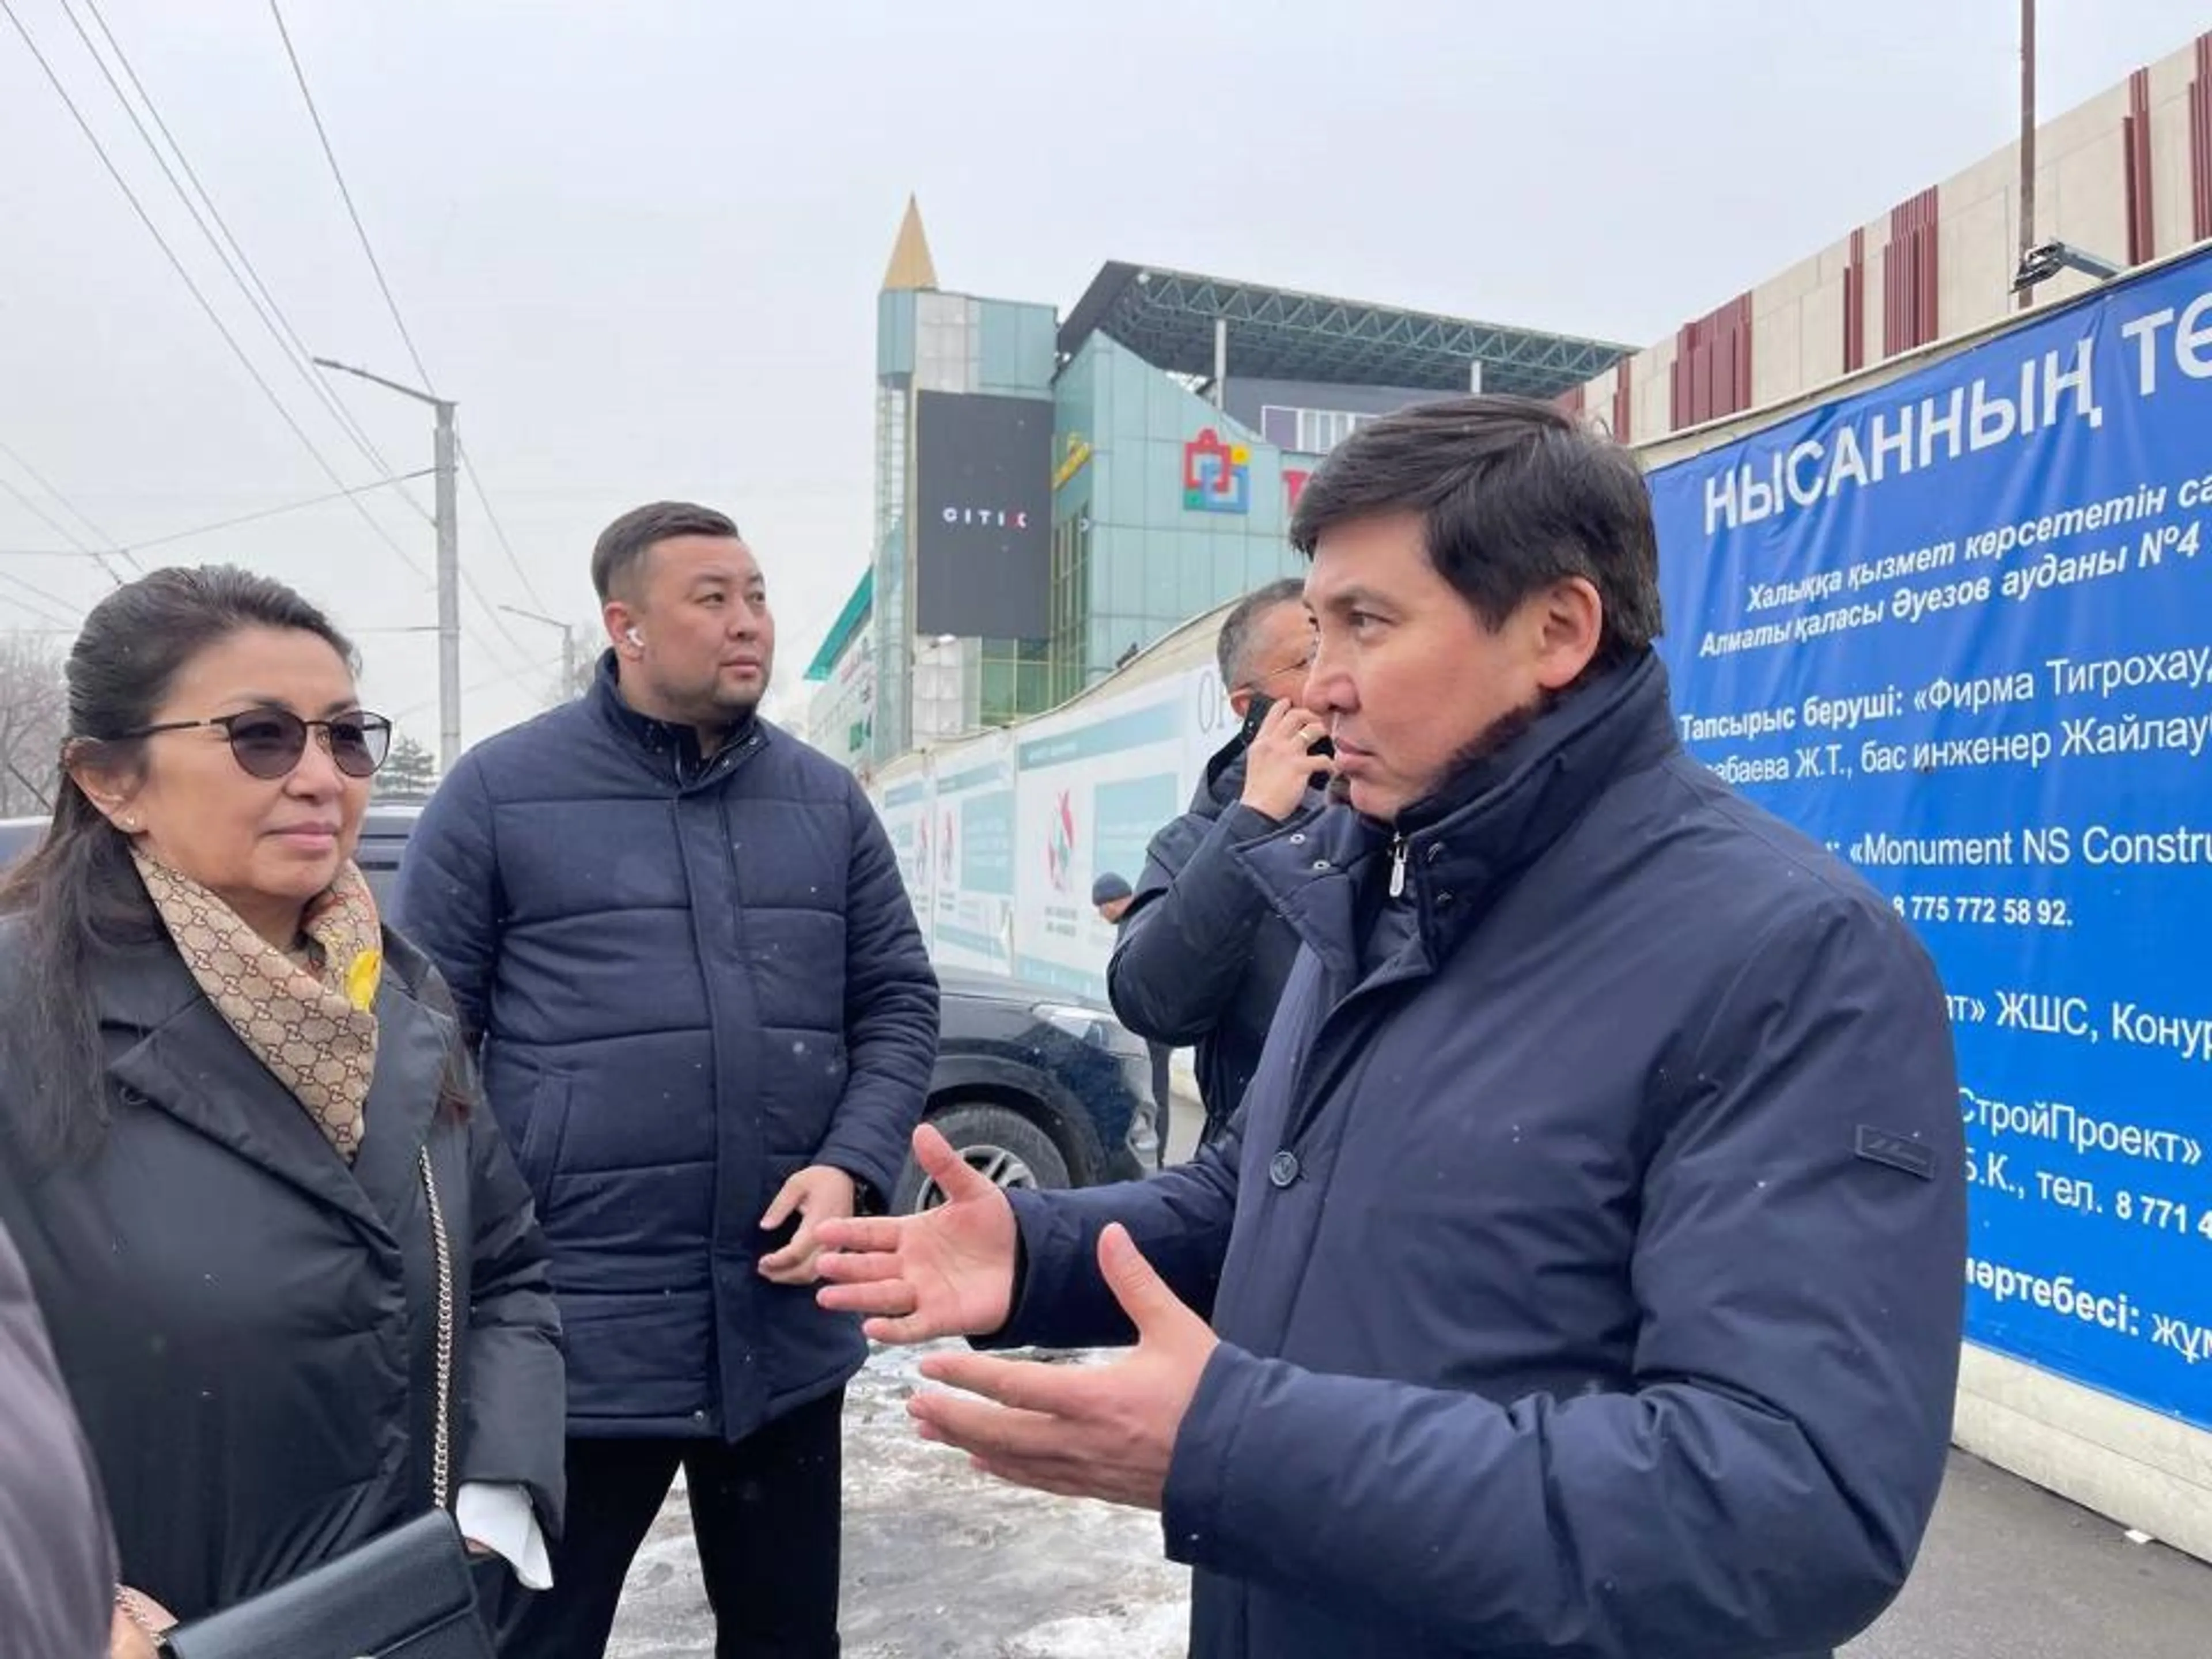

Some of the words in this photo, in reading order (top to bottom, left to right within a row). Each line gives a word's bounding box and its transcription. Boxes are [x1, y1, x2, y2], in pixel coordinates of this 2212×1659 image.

[1704, 336, 2103, 536] НЫСАННЫҢ
[1745, 570, 1843, 612] Халыққа
[1847, 540, 1957, 593] қызмет
[1964, 483, 2168, 562] көрсететін
[1698, 624, 1790, 658] Алматы
[1793, 600, 1885, 643] қаласы
[1891, 576, 1992, 624] Әуезов
[2001, 546, 2129, 601] ауданы
[1679, 704, 1797, 742] Тапсырыс
[1802, 684, 1903, 730] беруші:
[1913, 671, 2035, 715] «Фирма
[2045, 645, 2212, 698] Тигрохау
[1705, 754, 1790, 784] абаева
[1861, 740, 1907, 774] бас
[1913, 731, 2052, 770] инженер
[2060, 713, 2212, 757] Жайлау
[1850, 831, 2013, 865] «Monument
[2023, 827, 2071, 865] NS
[1911, 896, 1950, 922] 775
[1957, 897, 1997, 923] 772
[2003, 898, 2032, 925] 58
[2036, 899, 2074, 927] 92.
[1995, 990, 2099, 1044] ЖШС,
[2035, 1171, 2103, 1214] тел.
[2115, 1191, 2133, 1220] 8
[2139, 1194, 2187, 1234] 771
